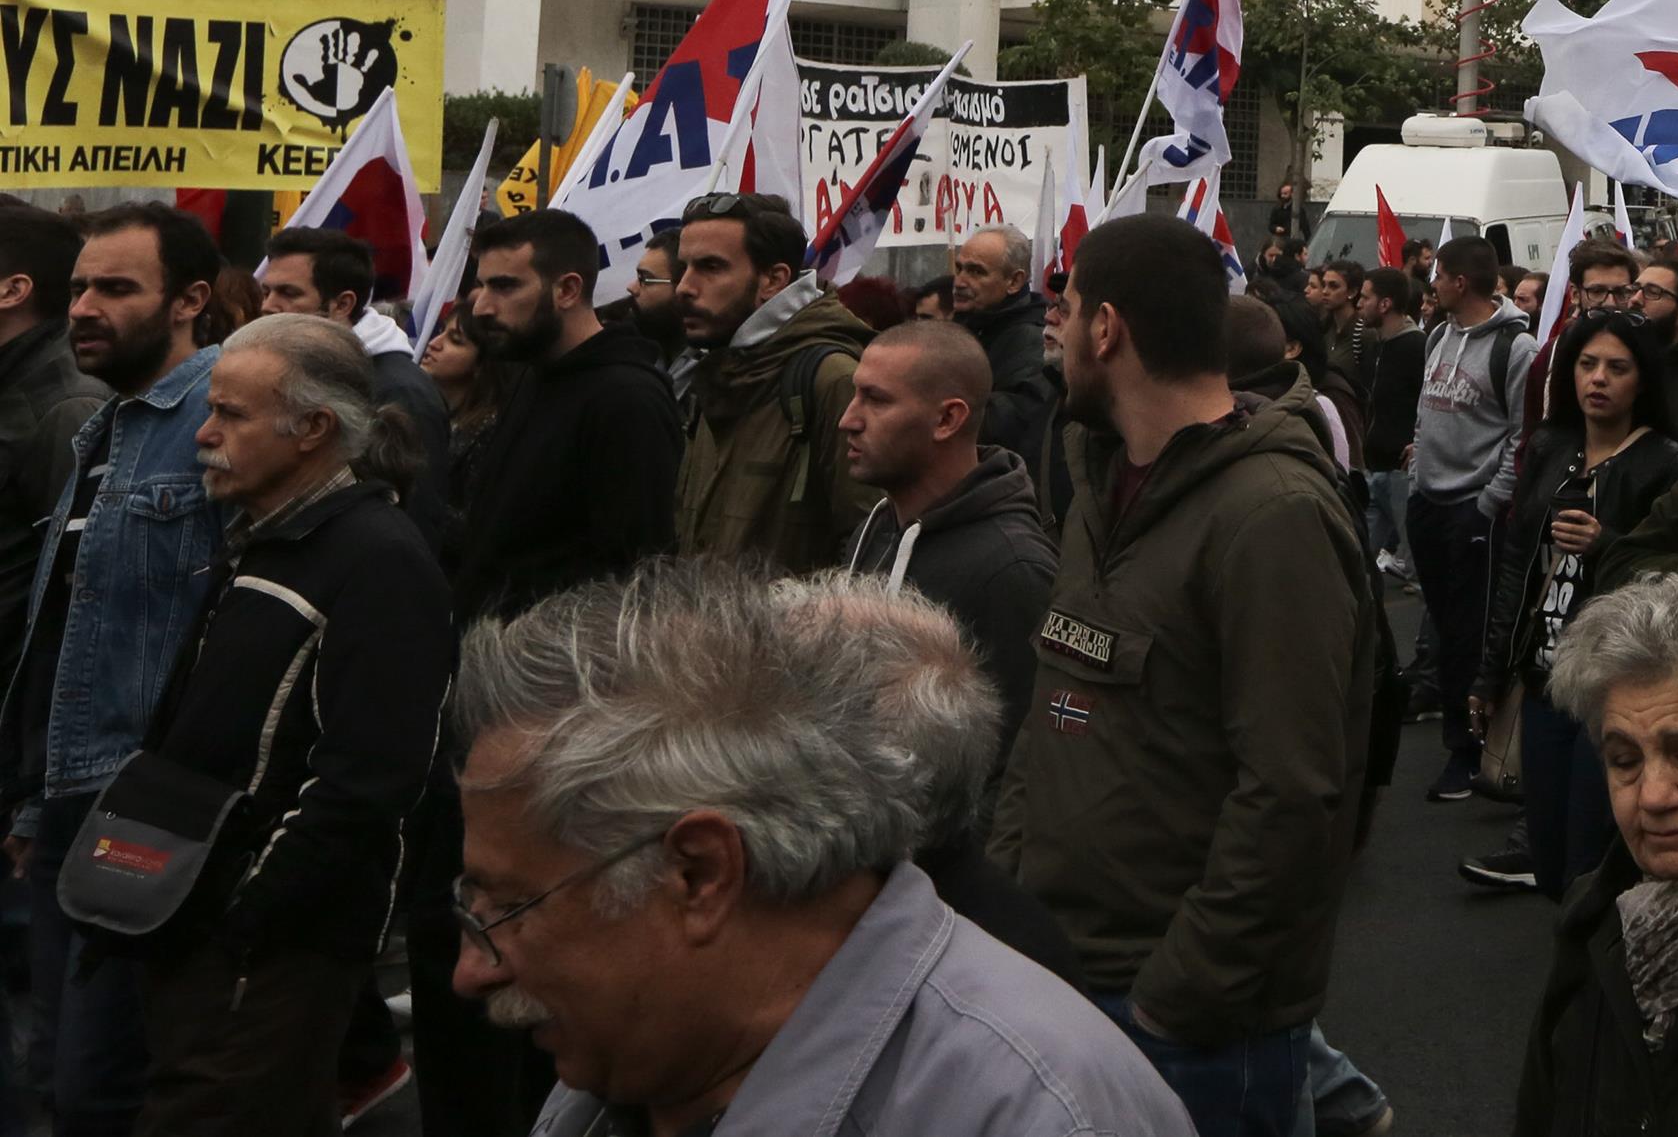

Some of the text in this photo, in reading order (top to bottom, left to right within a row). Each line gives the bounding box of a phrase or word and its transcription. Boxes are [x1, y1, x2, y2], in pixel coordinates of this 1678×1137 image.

[98, 13, 267, 132] ΝΑΖΙ
[0, 145, 61, 173] ΤΙΚΗ
[68, 145, 188, 174] ΑΠΕΙΛΗ
